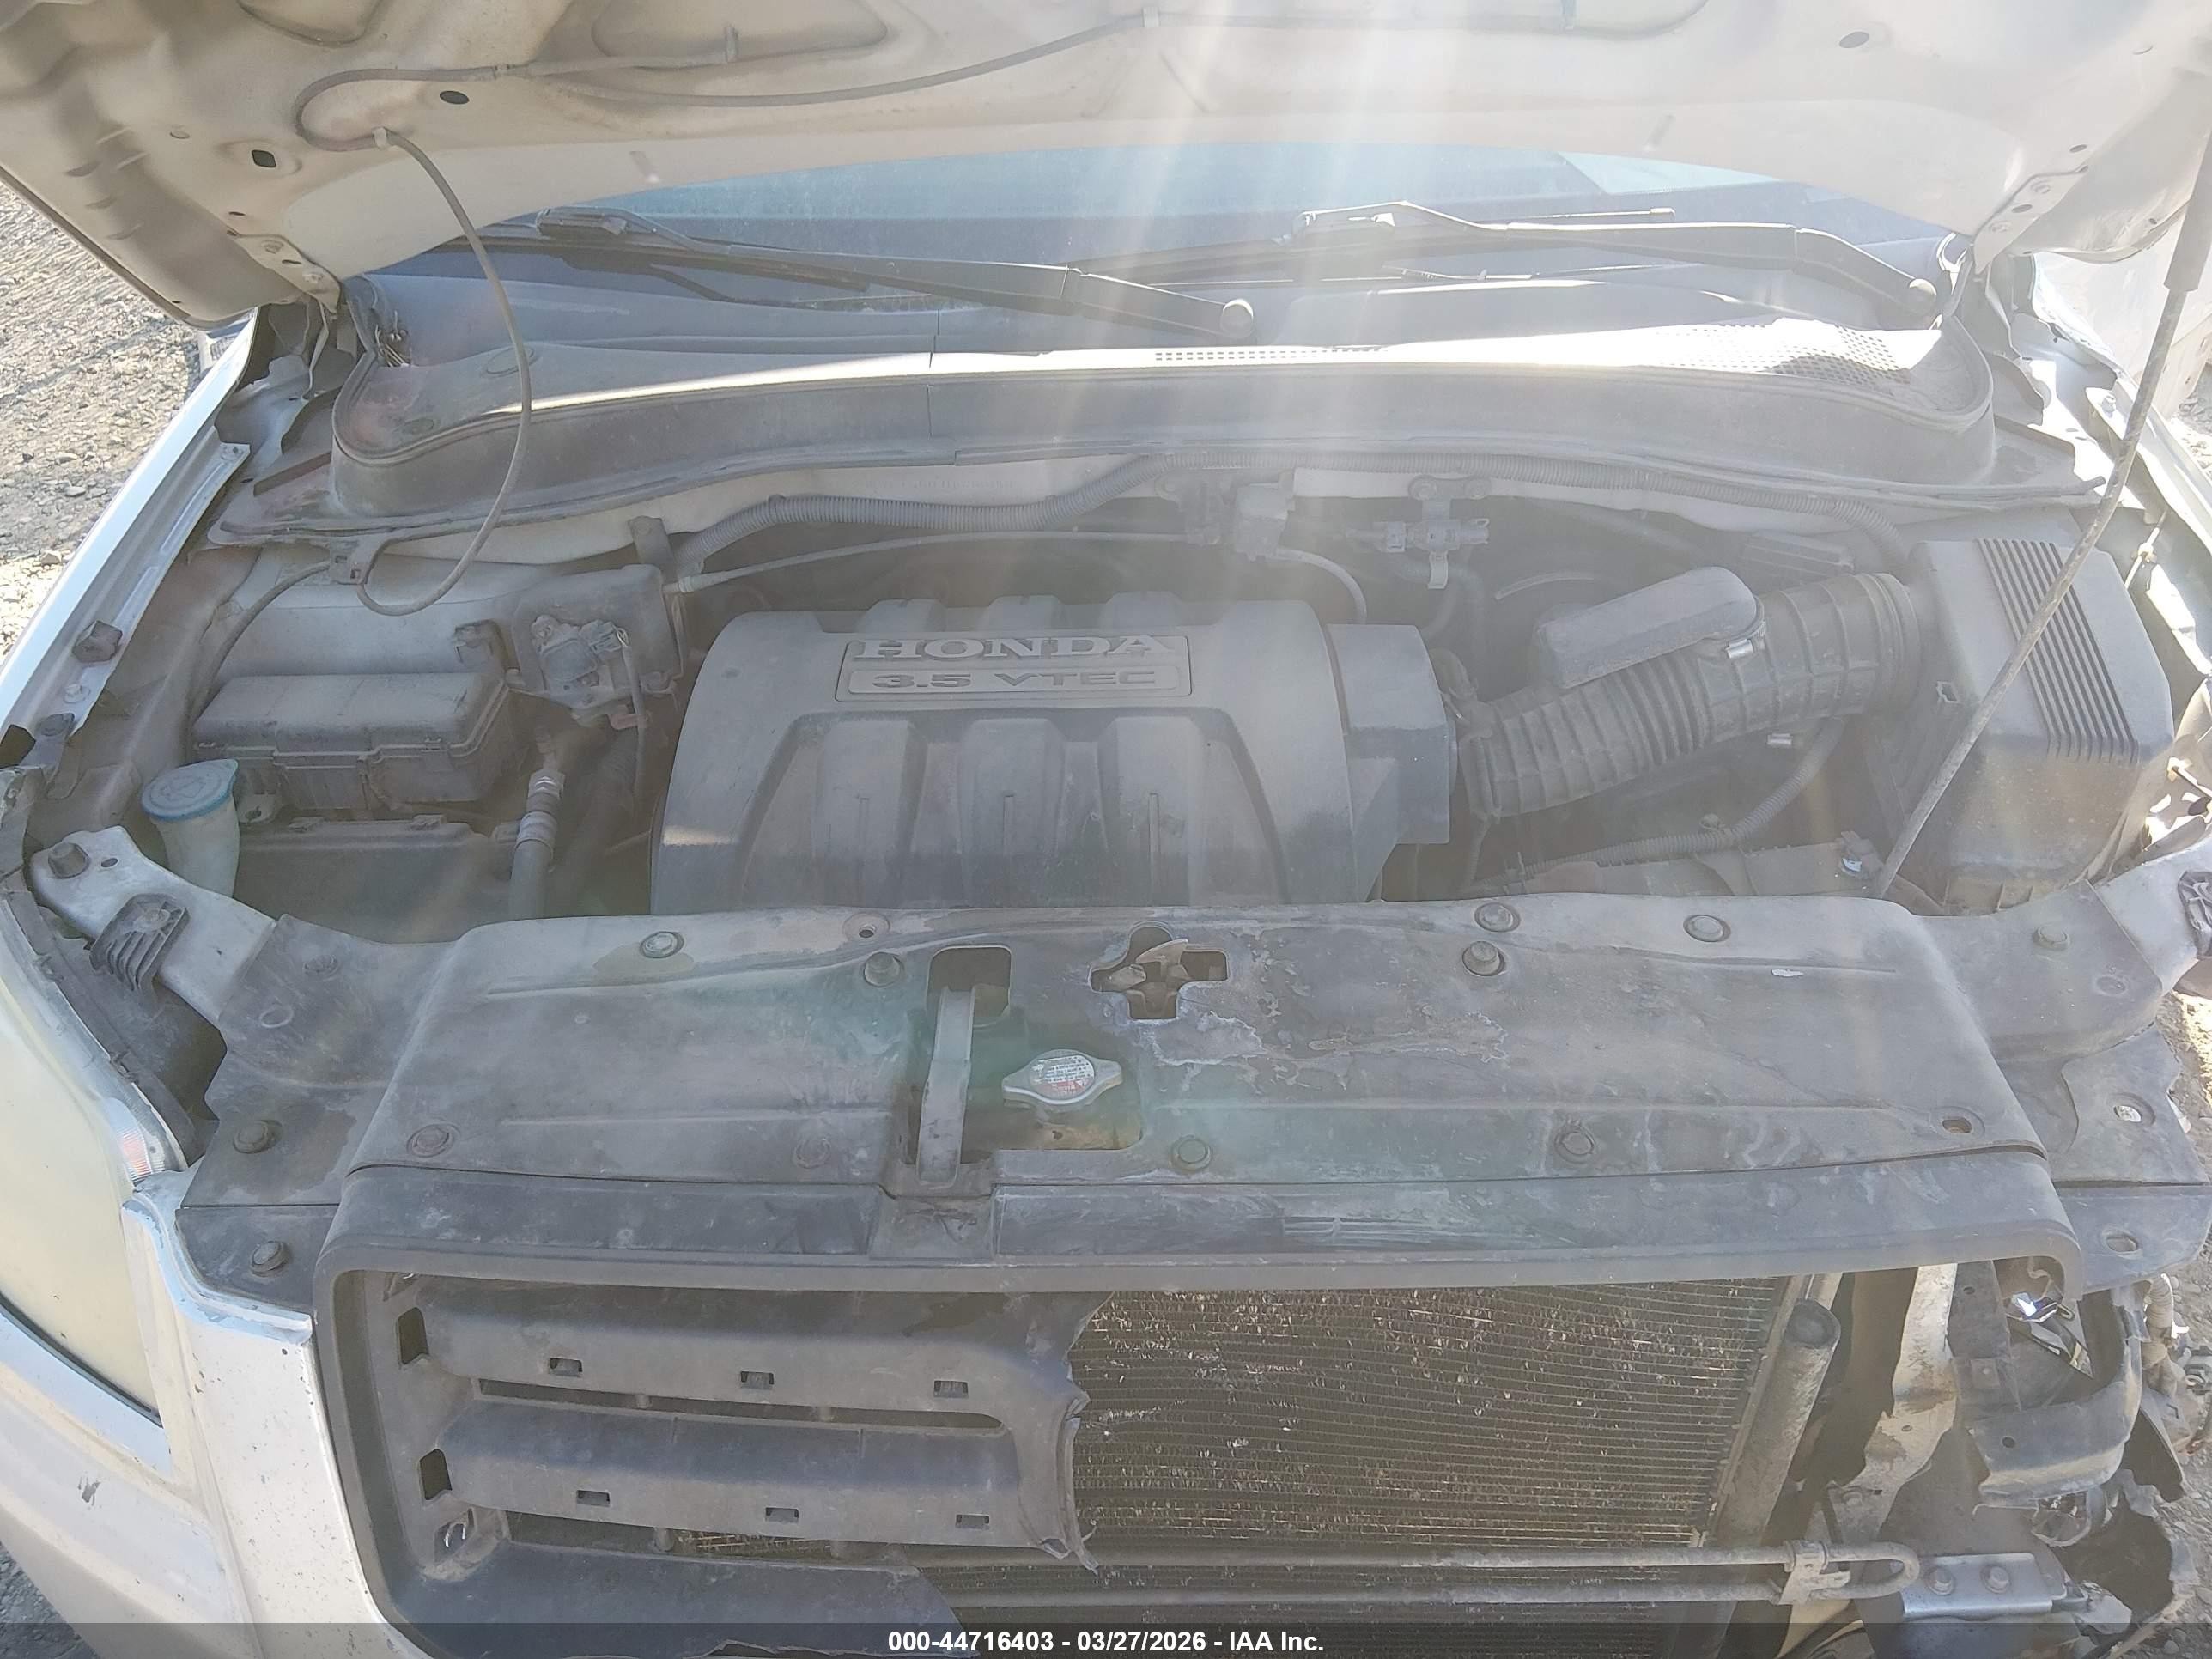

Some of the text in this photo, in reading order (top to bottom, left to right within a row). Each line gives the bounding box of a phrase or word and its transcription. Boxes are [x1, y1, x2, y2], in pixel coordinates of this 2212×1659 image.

[854, 635, 1172, 659] HONDA
[872, 671, 1155, 687] 3.5 VTEC
